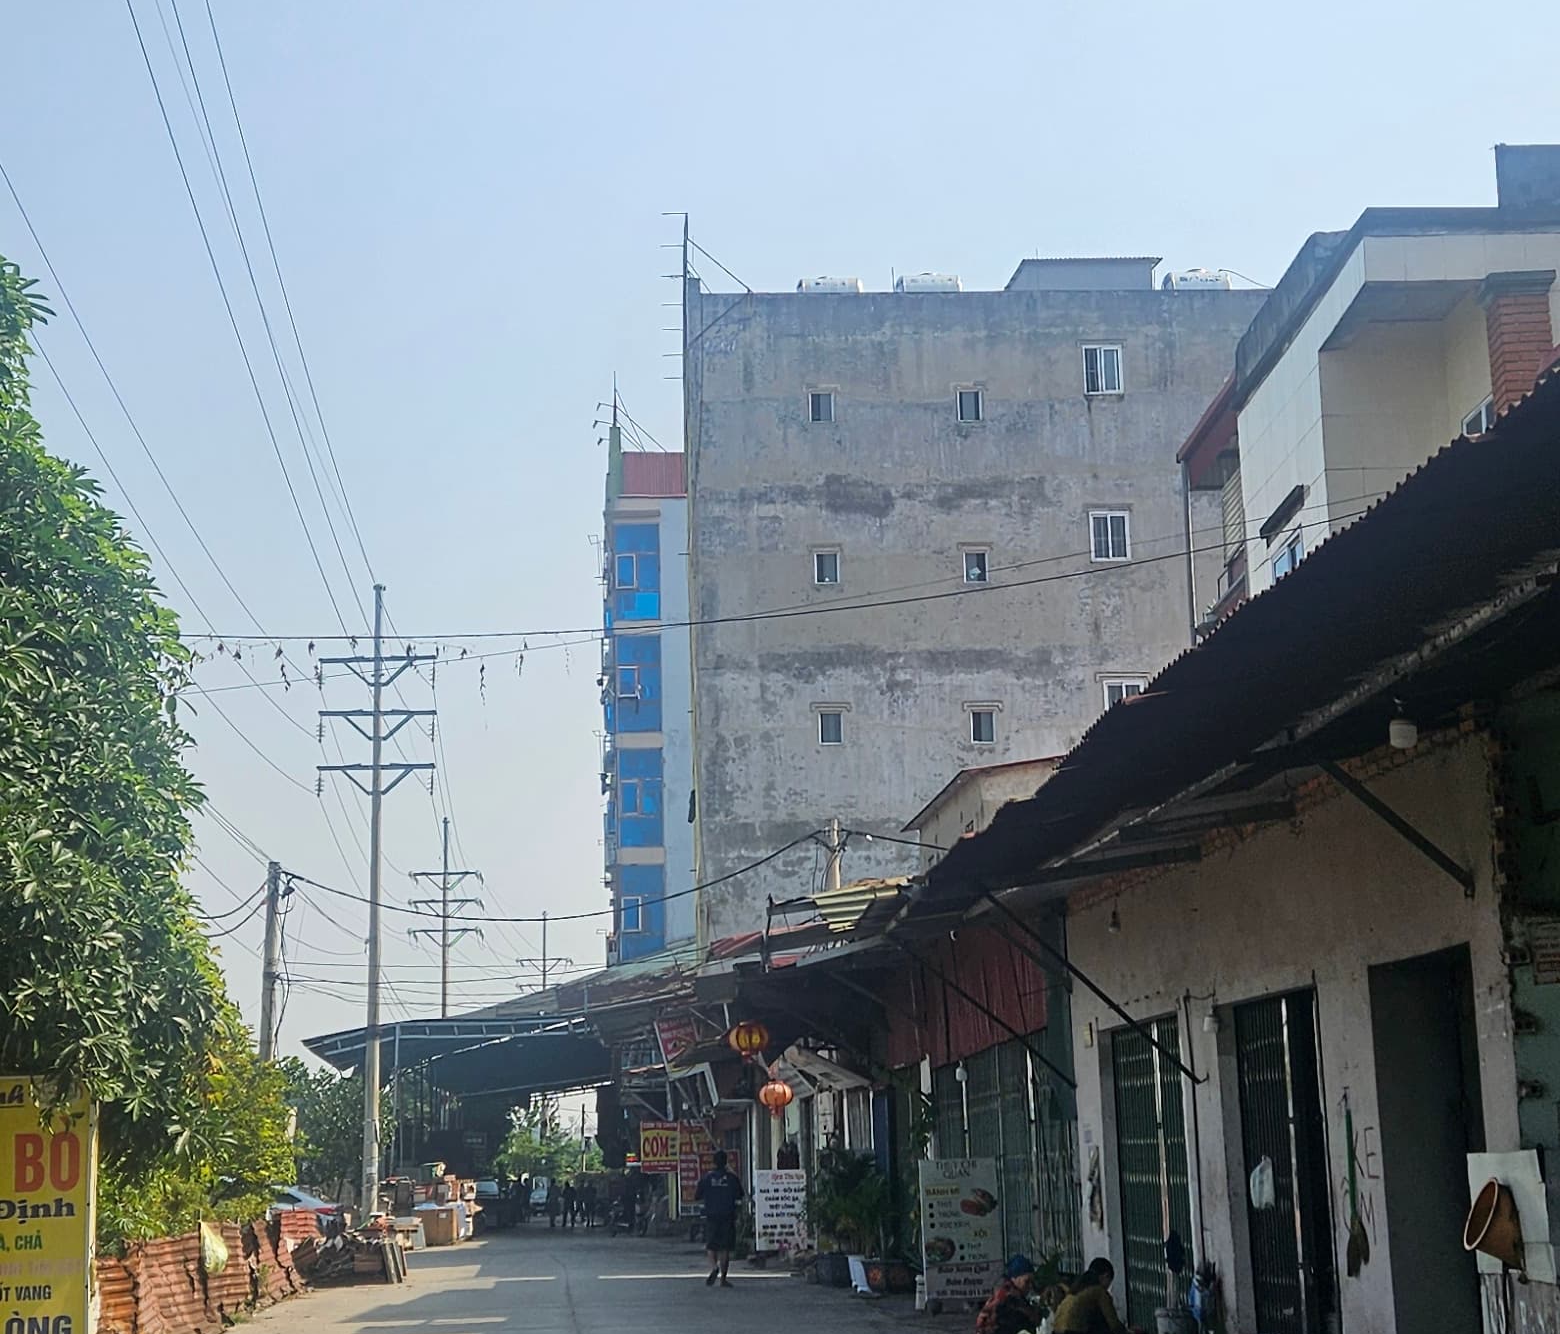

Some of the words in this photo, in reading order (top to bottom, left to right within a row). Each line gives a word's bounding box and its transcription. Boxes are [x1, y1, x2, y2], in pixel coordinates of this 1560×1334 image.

[0, 1198, 75, 1224] Định
[15, 1229, 43, 1250] CHẢ
[15, 1285, 52, 1301] VANG
